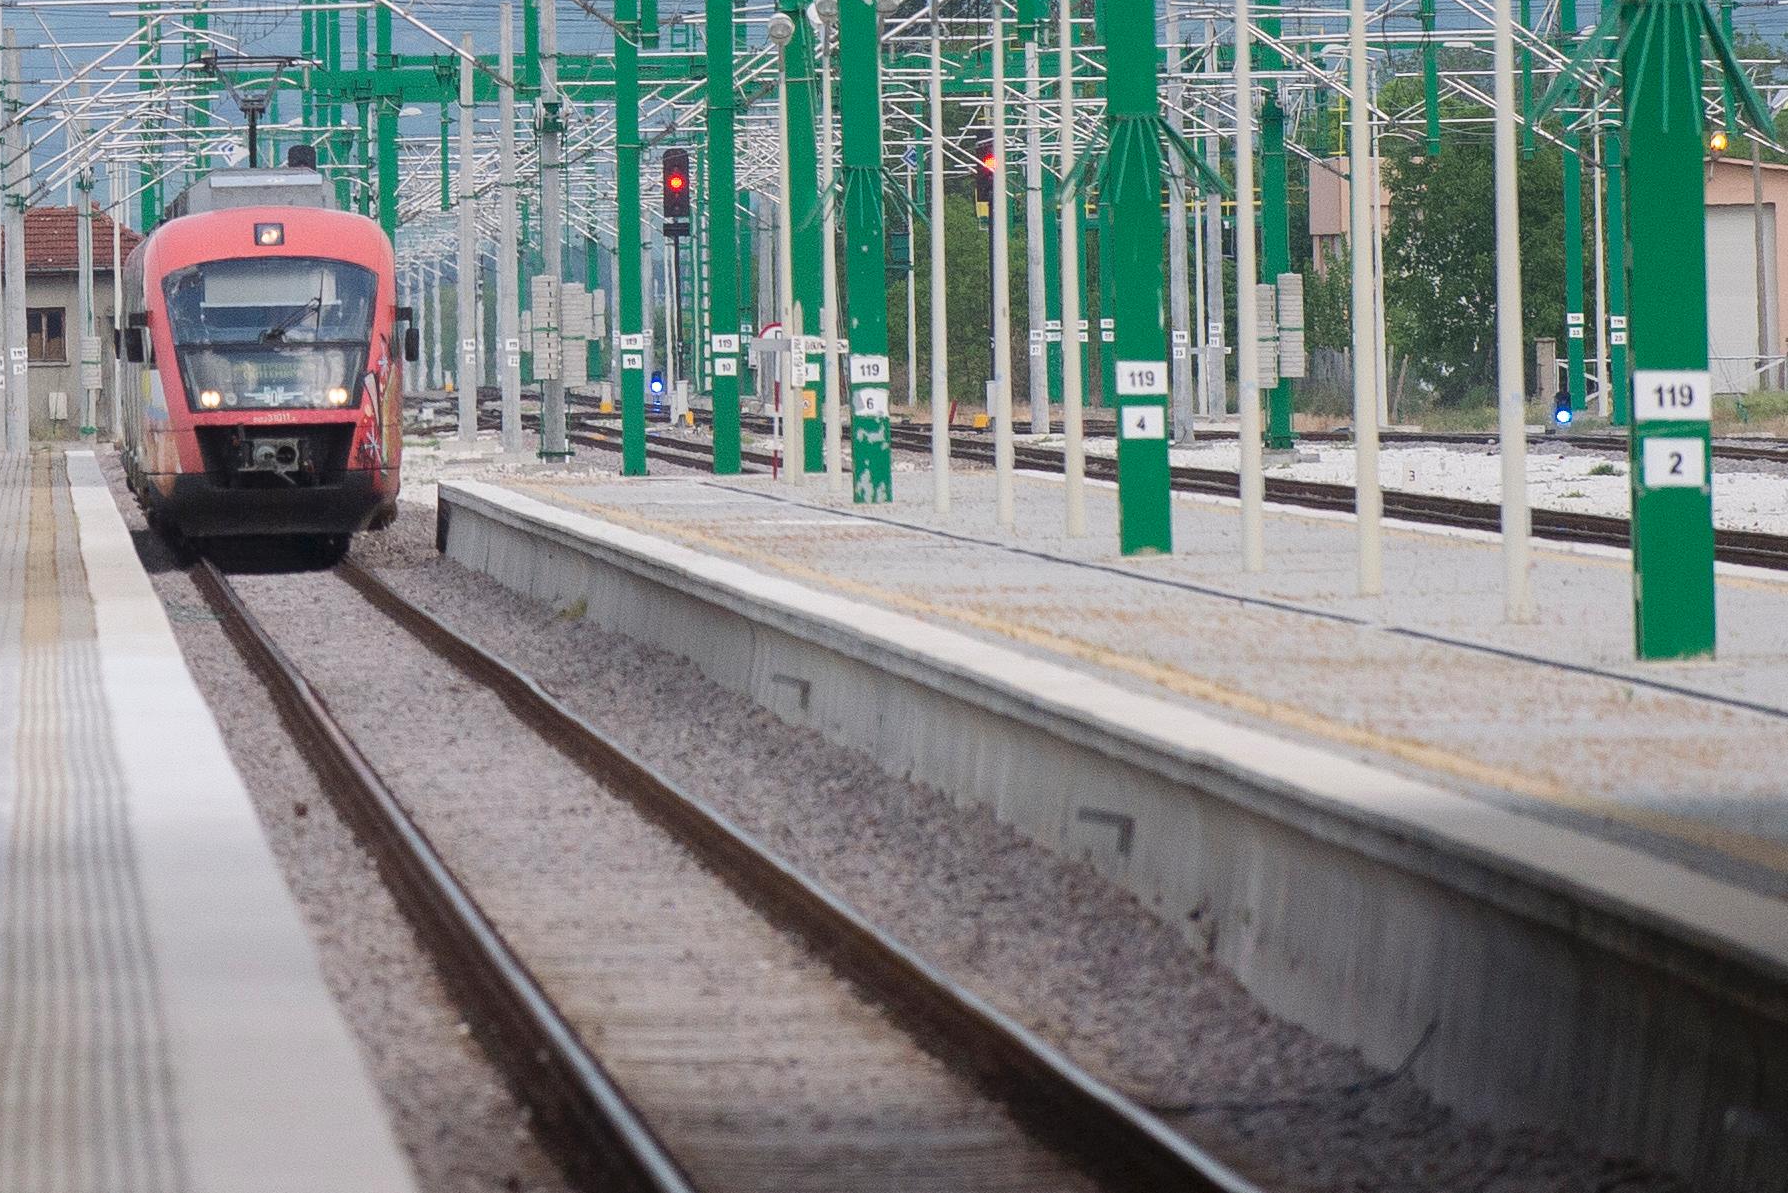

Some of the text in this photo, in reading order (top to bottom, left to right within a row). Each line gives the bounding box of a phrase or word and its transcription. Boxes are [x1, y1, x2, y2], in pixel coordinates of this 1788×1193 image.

[718, 338, 732, 348] 119
[721, 362, 732, 372] 10
[859, 363, 880, 377] 119
[1128, 370, 1156, 387] 119
[1653, 383, 1694, 408] 119
[866, 397, 874, 410] 6
[1136, 415, 1146, 431] 4
[1669, 451, 1683, 475] 2
[1408, 470, 1416, 482] 3
